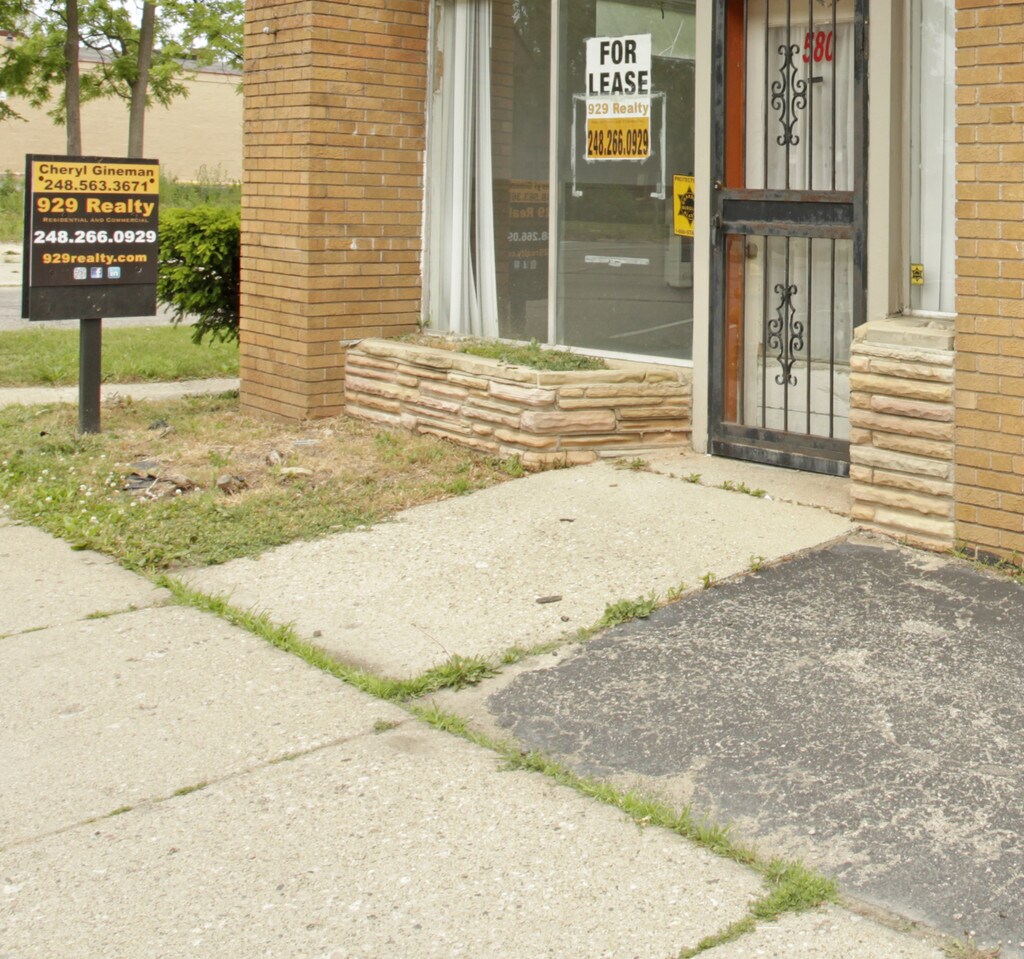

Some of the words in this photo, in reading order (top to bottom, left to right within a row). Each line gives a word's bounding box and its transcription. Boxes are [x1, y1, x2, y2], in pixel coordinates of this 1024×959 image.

[599, 39, 637, 65] FOR
[588, 70, 649, 96] LEASE
[588, 102, 609, 114] 929
[613, 102, 649, 115] Realty
[587, 129, 649, 156] 248.266.0929
[39, 164, 87, 177] Cheryl
[92, 165, 154, 176] Gineman
[44, 179, 148, 191] 248.563.3671
[36, 197, 79, 213] 929
[86, 198, 155, 217] Realty
[33, 230, 157, 243] 248.266.0929
[42, 253, 148, 265] 929realty.com
